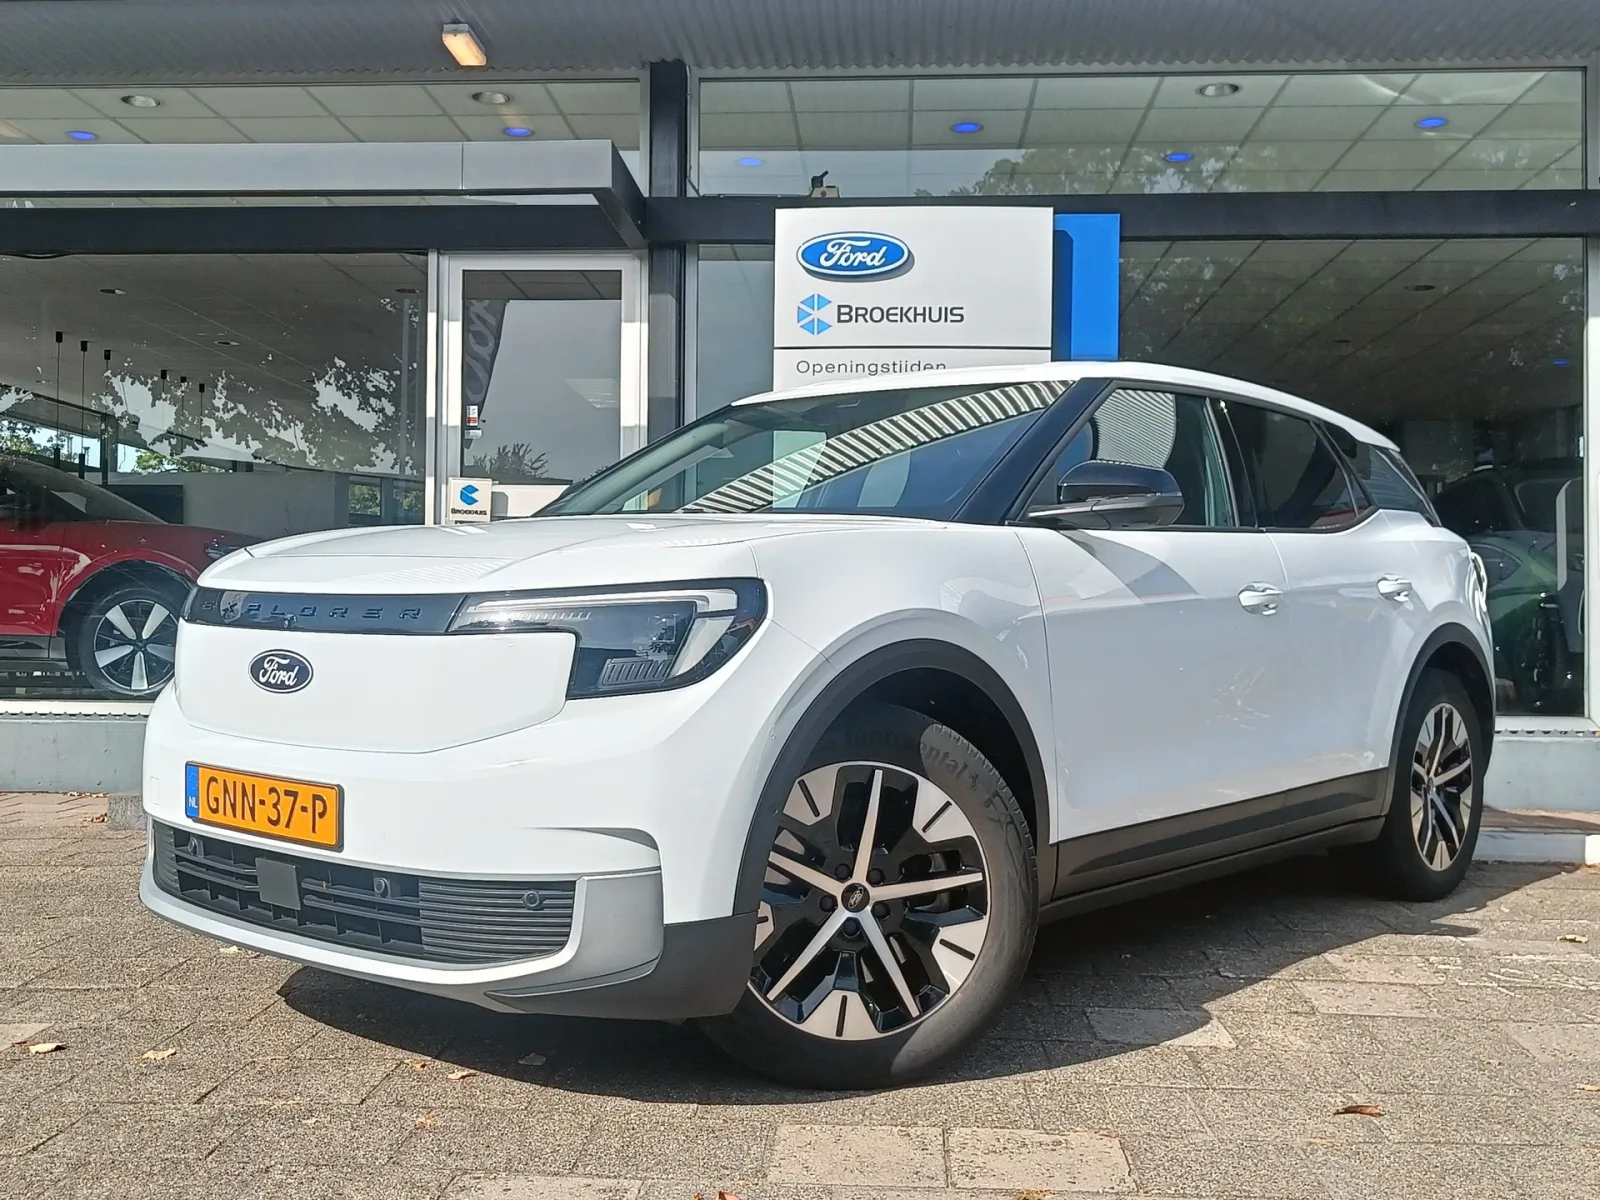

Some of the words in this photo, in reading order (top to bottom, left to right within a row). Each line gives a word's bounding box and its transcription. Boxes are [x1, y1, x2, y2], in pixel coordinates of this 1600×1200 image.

[818, 239, 888, 268] Ford
[836, 304, 965, 324] BROEKHUIS
[259, 655, 298, 686] Ford
[188, 795, 198, 809] NL
[206, 776, 328, 834] GNN-37-P
